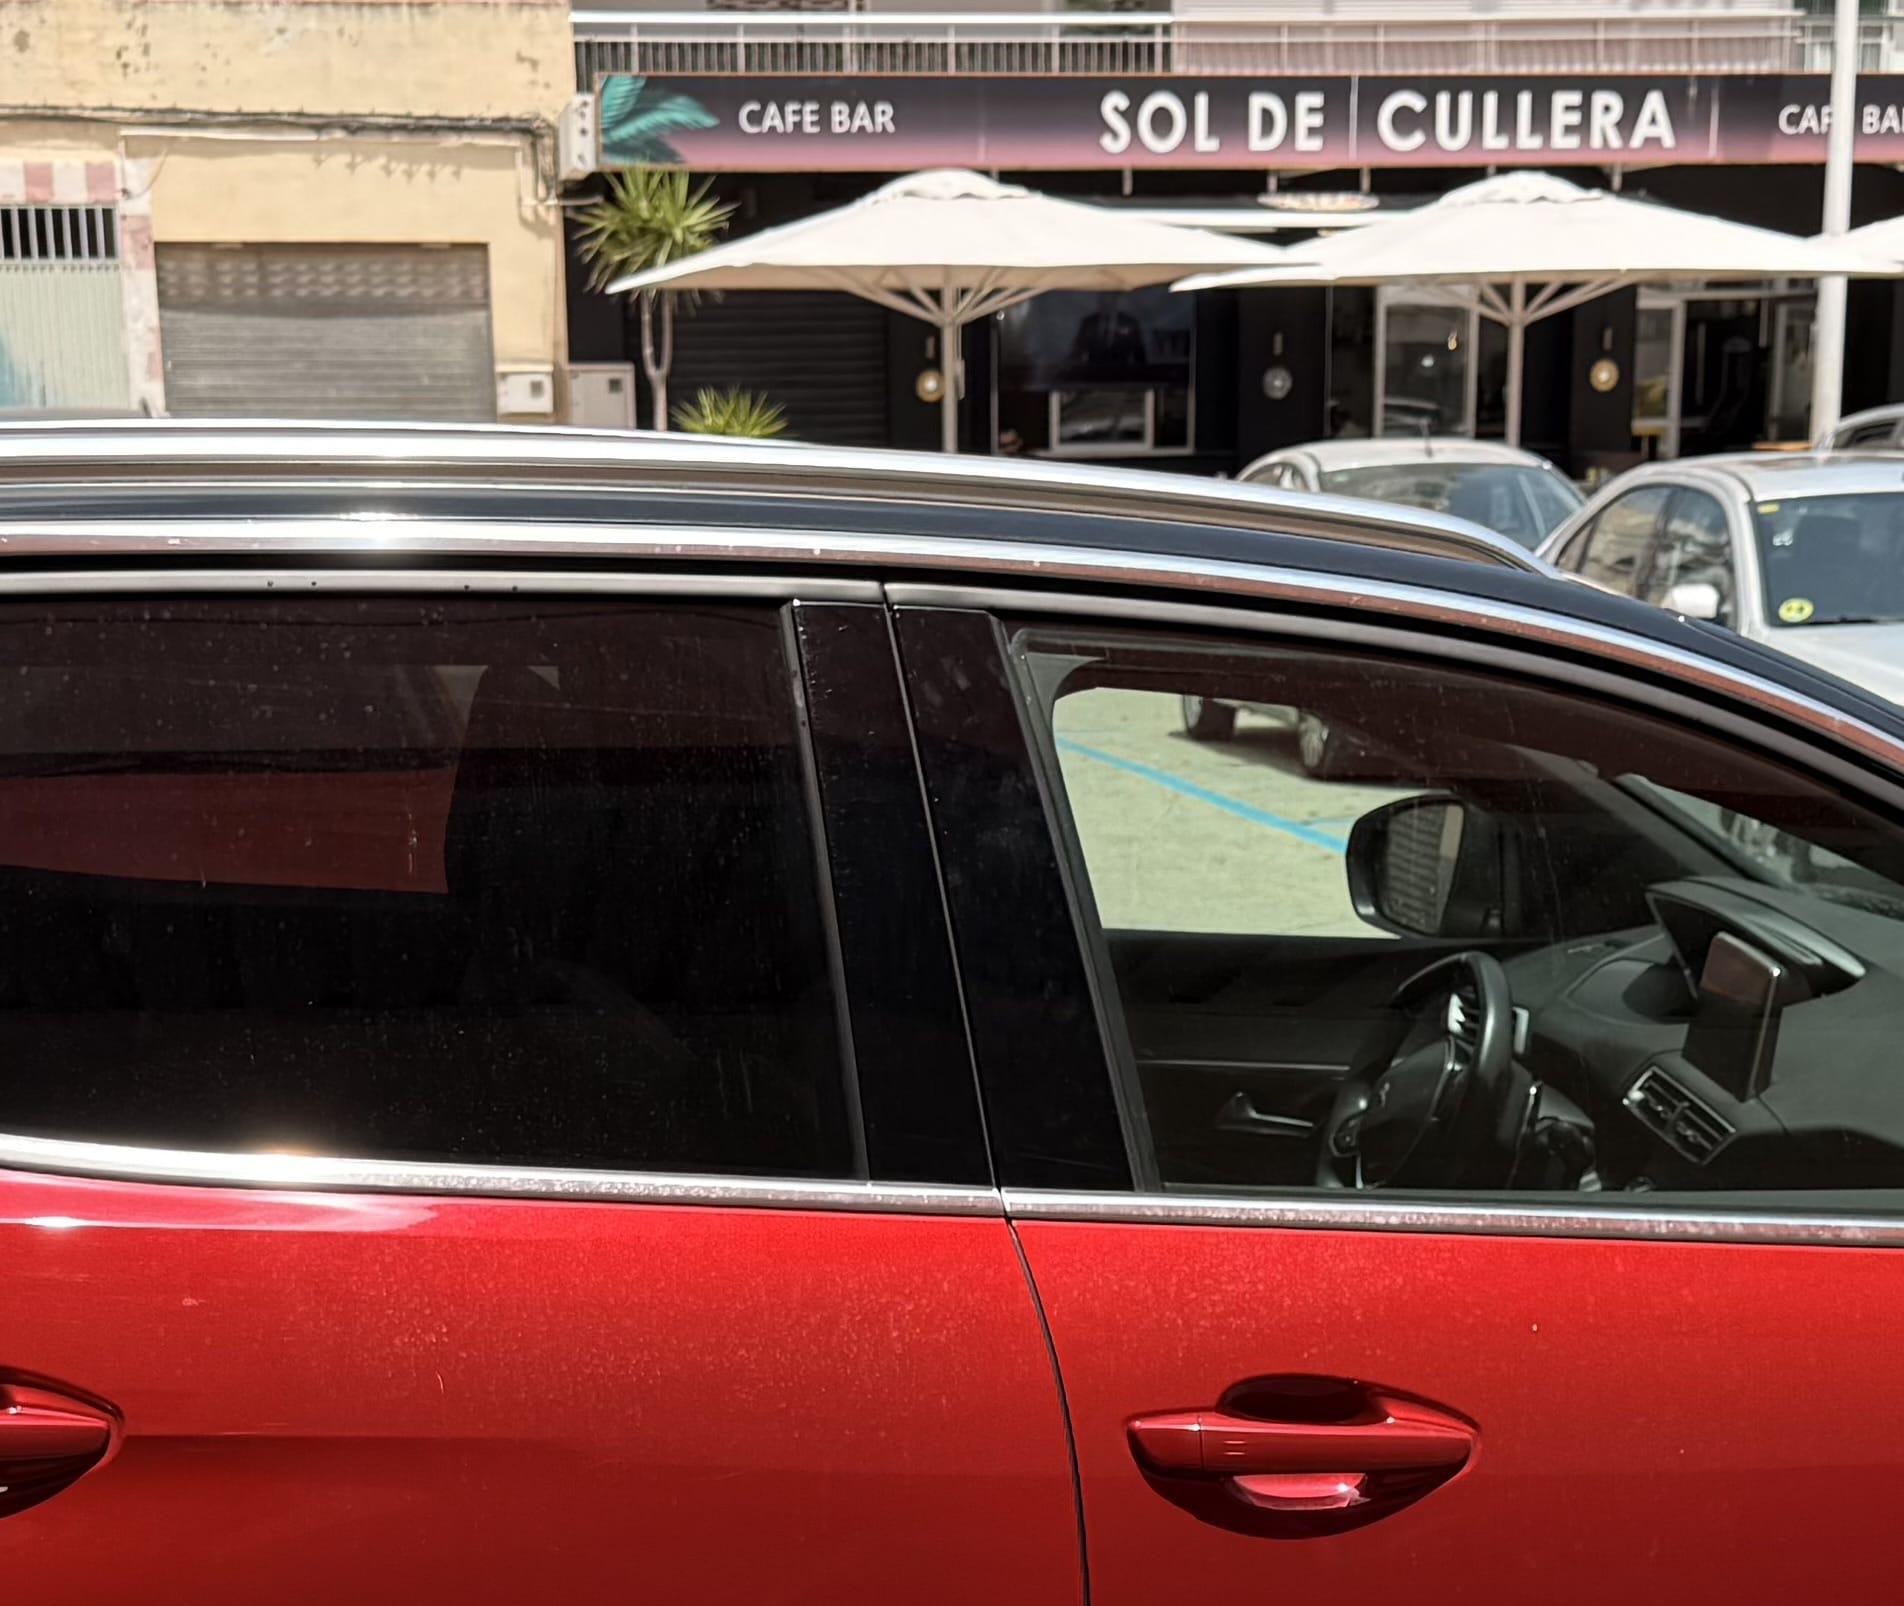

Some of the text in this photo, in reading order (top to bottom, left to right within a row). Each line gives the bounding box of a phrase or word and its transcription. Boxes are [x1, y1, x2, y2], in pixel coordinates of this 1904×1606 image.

[737, 100, 896, 135] CAFE BAR
[1099, 89, 1677, 154] SOL DE CULLERA
[1778, 104, 1832, 135] CAF
